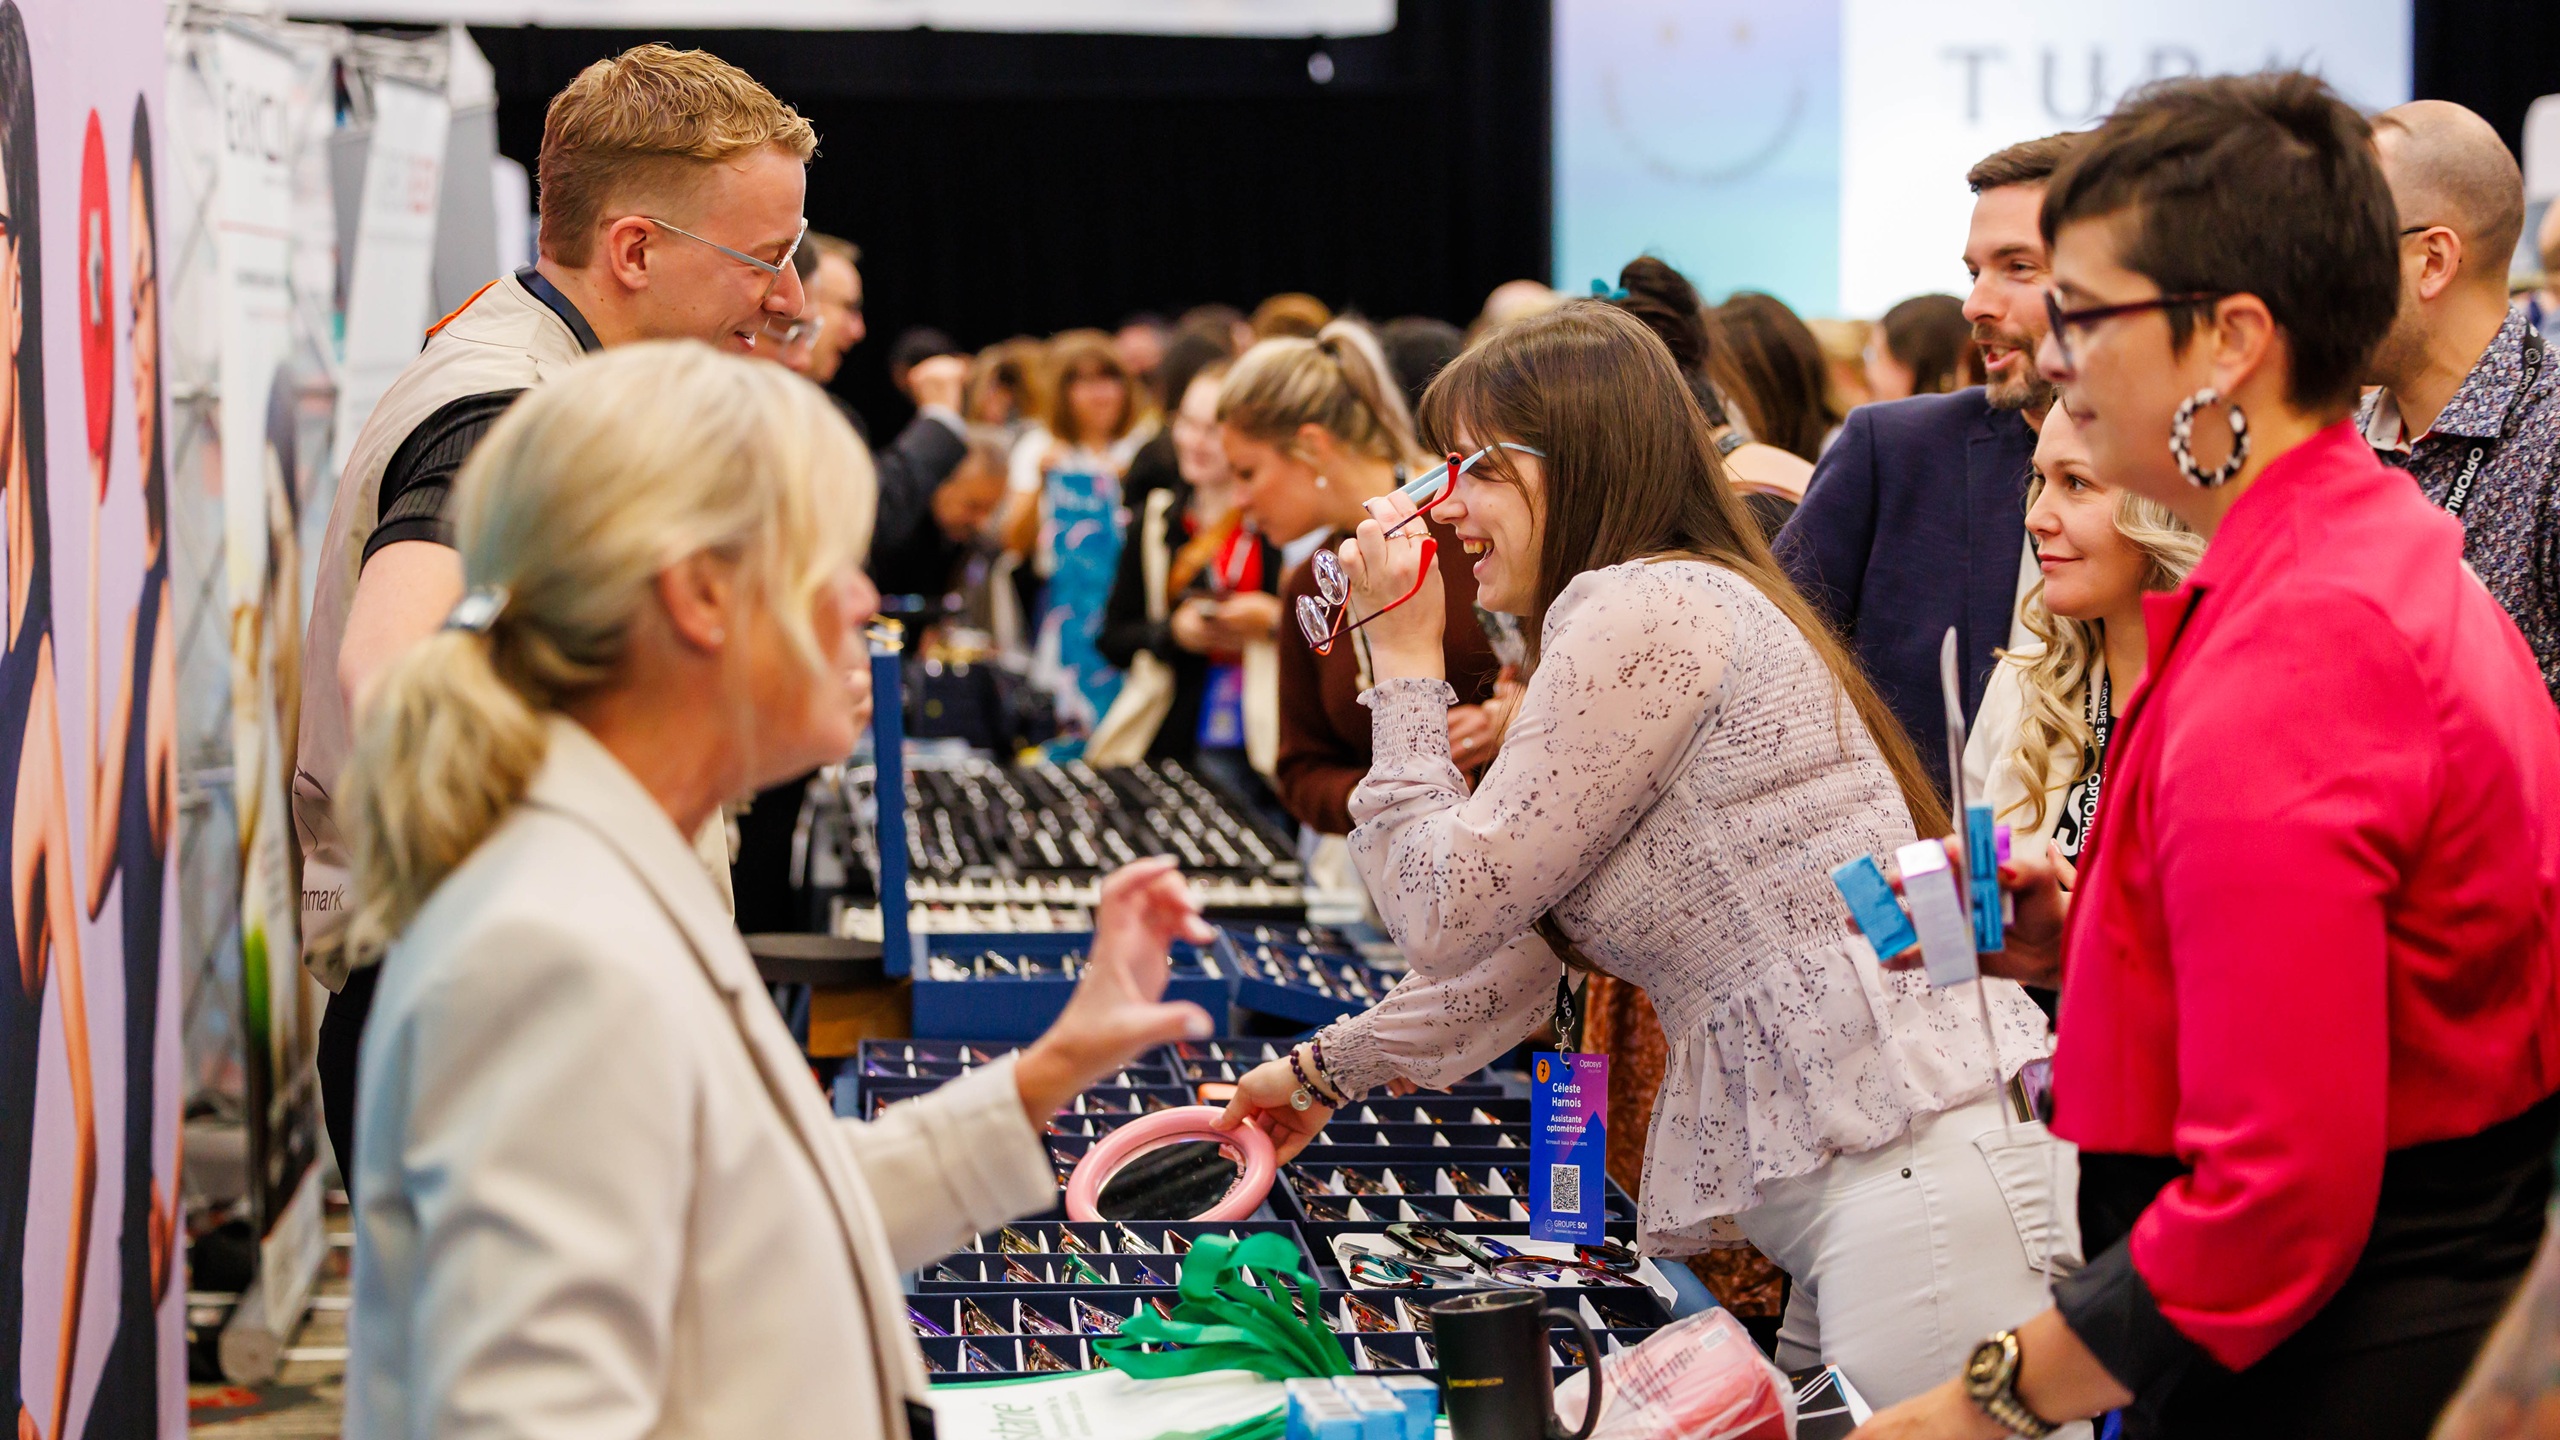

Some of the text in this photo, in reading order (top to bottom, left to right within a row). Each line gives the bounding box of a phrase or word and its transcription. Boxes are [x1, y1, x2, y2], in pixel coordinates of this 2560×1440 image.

[1579, 1059, 1602, 1069] Optosys
[1552, 1082, 1581, 1094] Céleste
[1551, 1096, 1582, 1108] Harnois
[1550, 1114, 1583, 1124] Assistante
[1546, 1124, 1587, 1134] optométriste
[1553, 1219, 1588, 1230] GROUPE SOI
